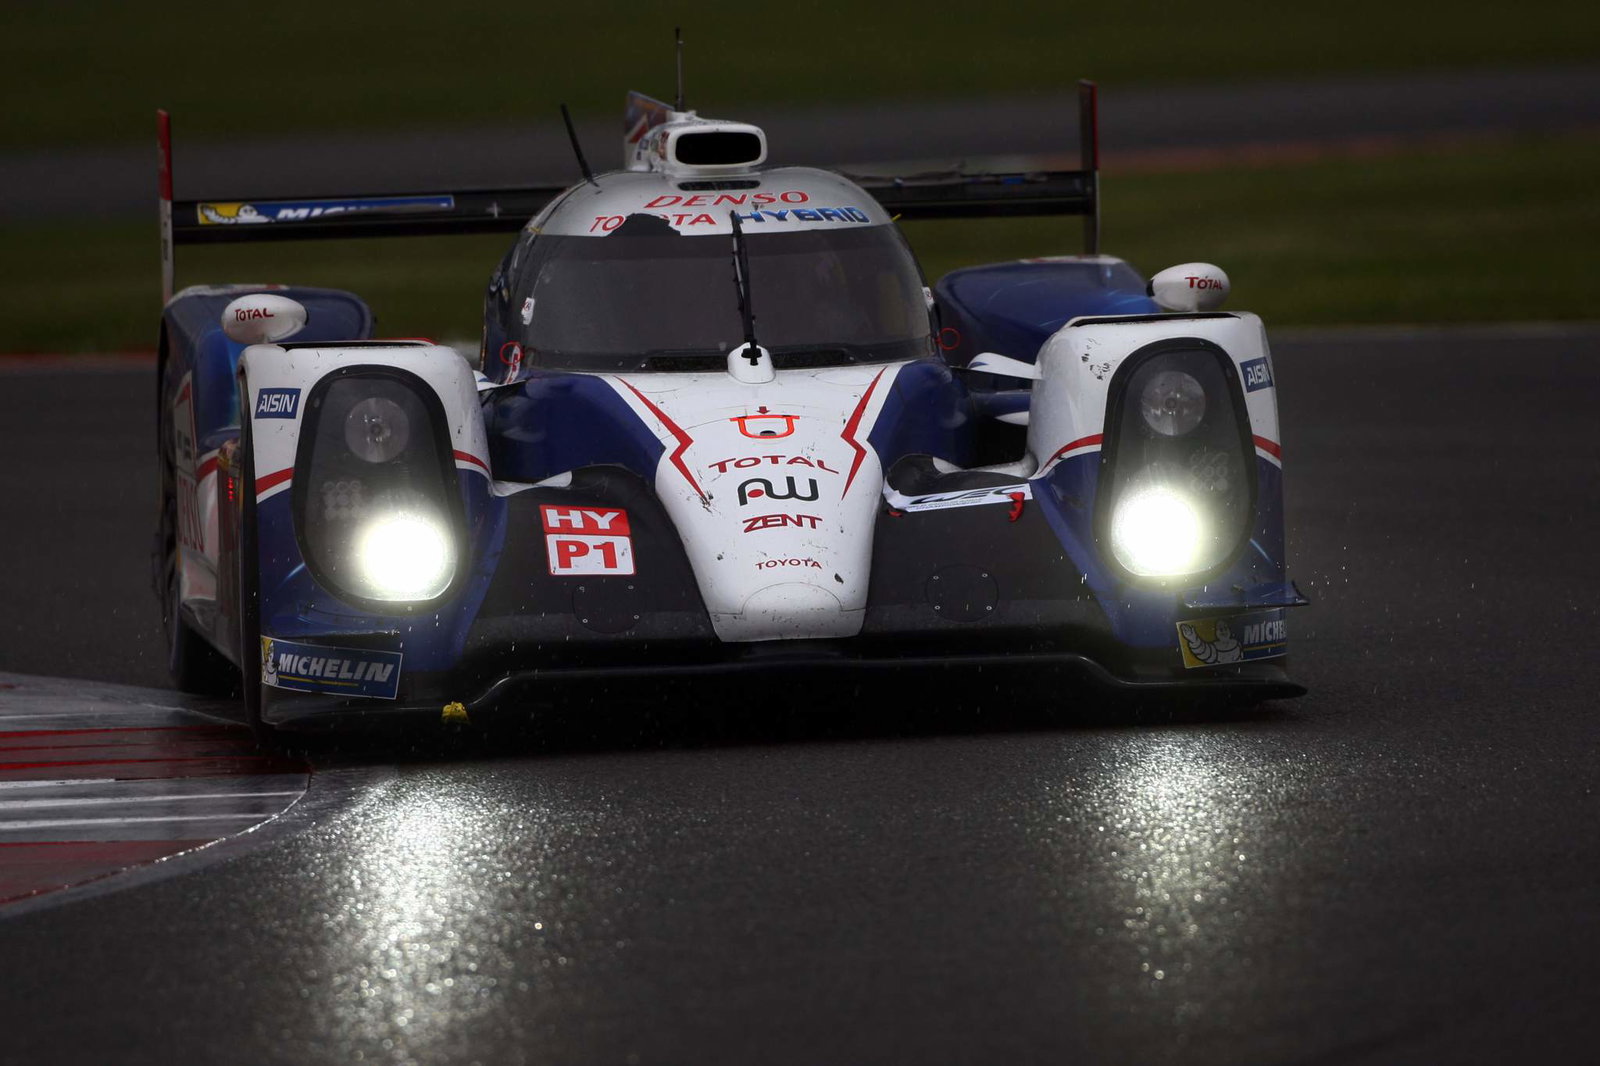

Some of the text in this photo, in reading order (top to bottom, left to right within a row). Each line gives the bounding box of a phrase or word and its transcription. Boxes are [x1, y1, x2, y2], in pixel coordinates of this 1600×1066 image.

[644, 191, 810, 209] DENSO
[588, 206, 871, 233] TOTA HYBRID
[1184, 276, 1223, 290] TOTAL
[234, 307, 275, 322] TOTAL
[257, 393, 296, 413] AISIN
[708, 455, 840, 475] TOTAL
[545, 508, 620, 530] HY
[742, 513, 823, 534] ZENT
[555, 540, 618, 569] P1
[755, 557, 823, 571] TOYOTA
[278, 653, 394, 682] MICHELIN
